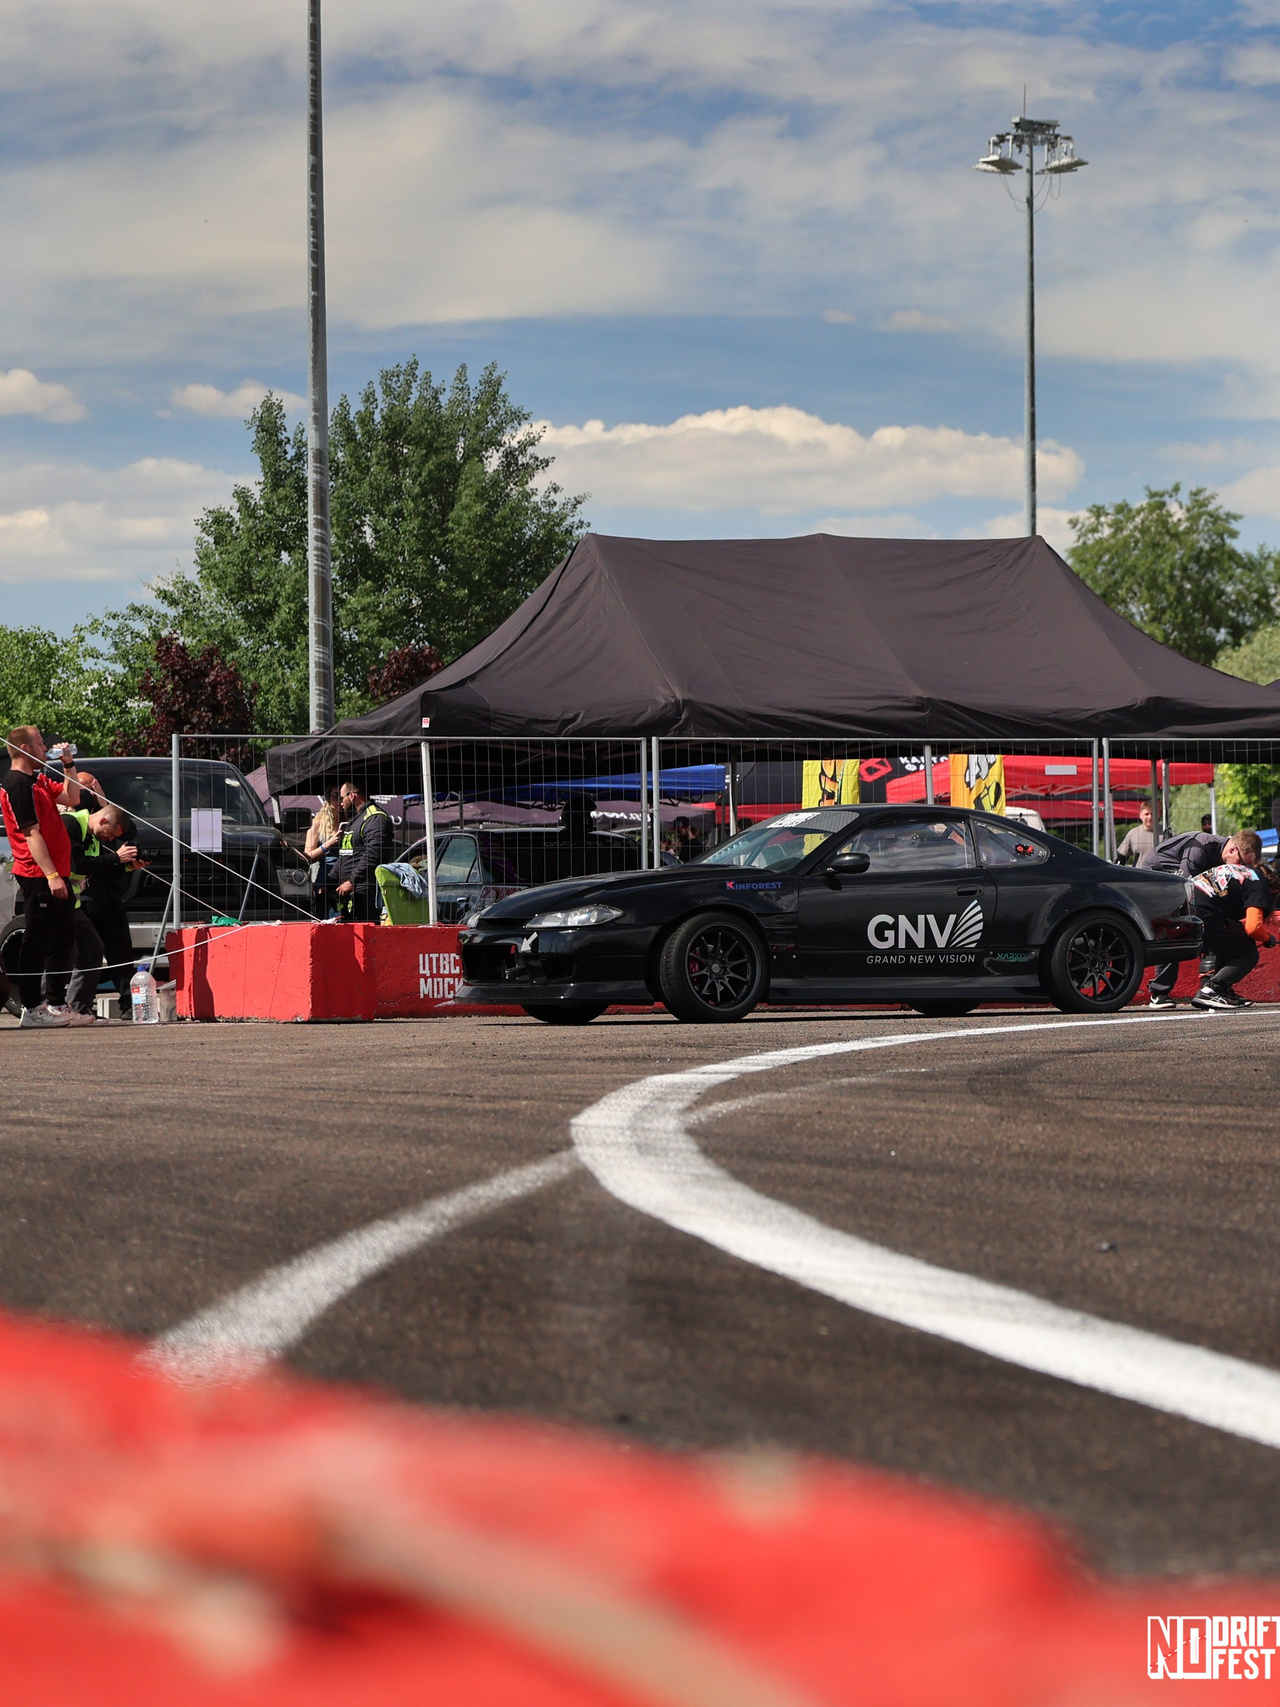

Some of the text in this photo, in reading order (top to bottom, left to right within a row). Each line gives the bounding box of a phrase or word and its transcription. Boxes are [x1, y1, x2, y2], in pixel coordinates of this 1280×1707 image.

[726, 880, 783, 890] KINFOREST
[867, 914, 957, 949] GNV
[419, 953, 460, 976] ЦТВС
[866, 954, 976, 965] GRAND NEW VISION
